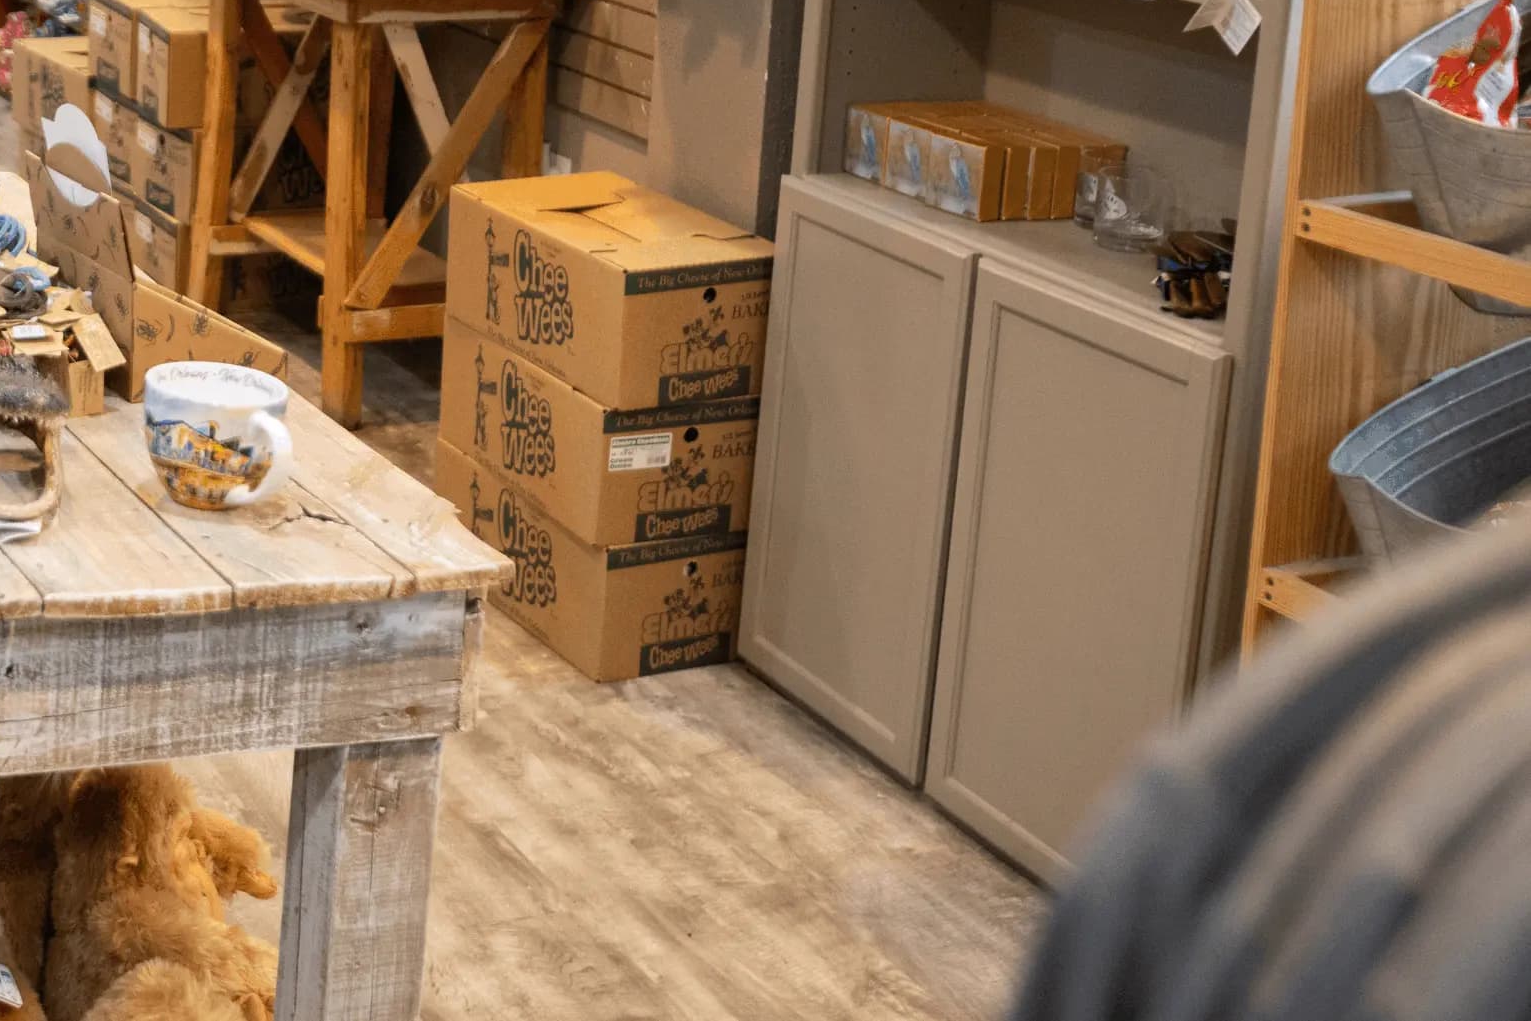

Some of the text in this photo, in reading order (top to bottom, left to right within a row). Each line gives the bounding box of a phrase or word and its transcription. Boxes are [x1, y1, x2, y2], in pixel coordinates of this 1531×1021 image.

[514, 229, 568, 303] Chee
[514, 294, 574, 346] Wees
[732, 301, 768, 319] BAK
[501, 359, 552, 435] Chee
[668, 370, 739, 401] Chee Wees
[501, 423, 556, 478] Wees
[498, 488, 553, 566] Chee
[645, 507, 719, 538] Chee Wees
[649, 645, 682, 669] Chee
